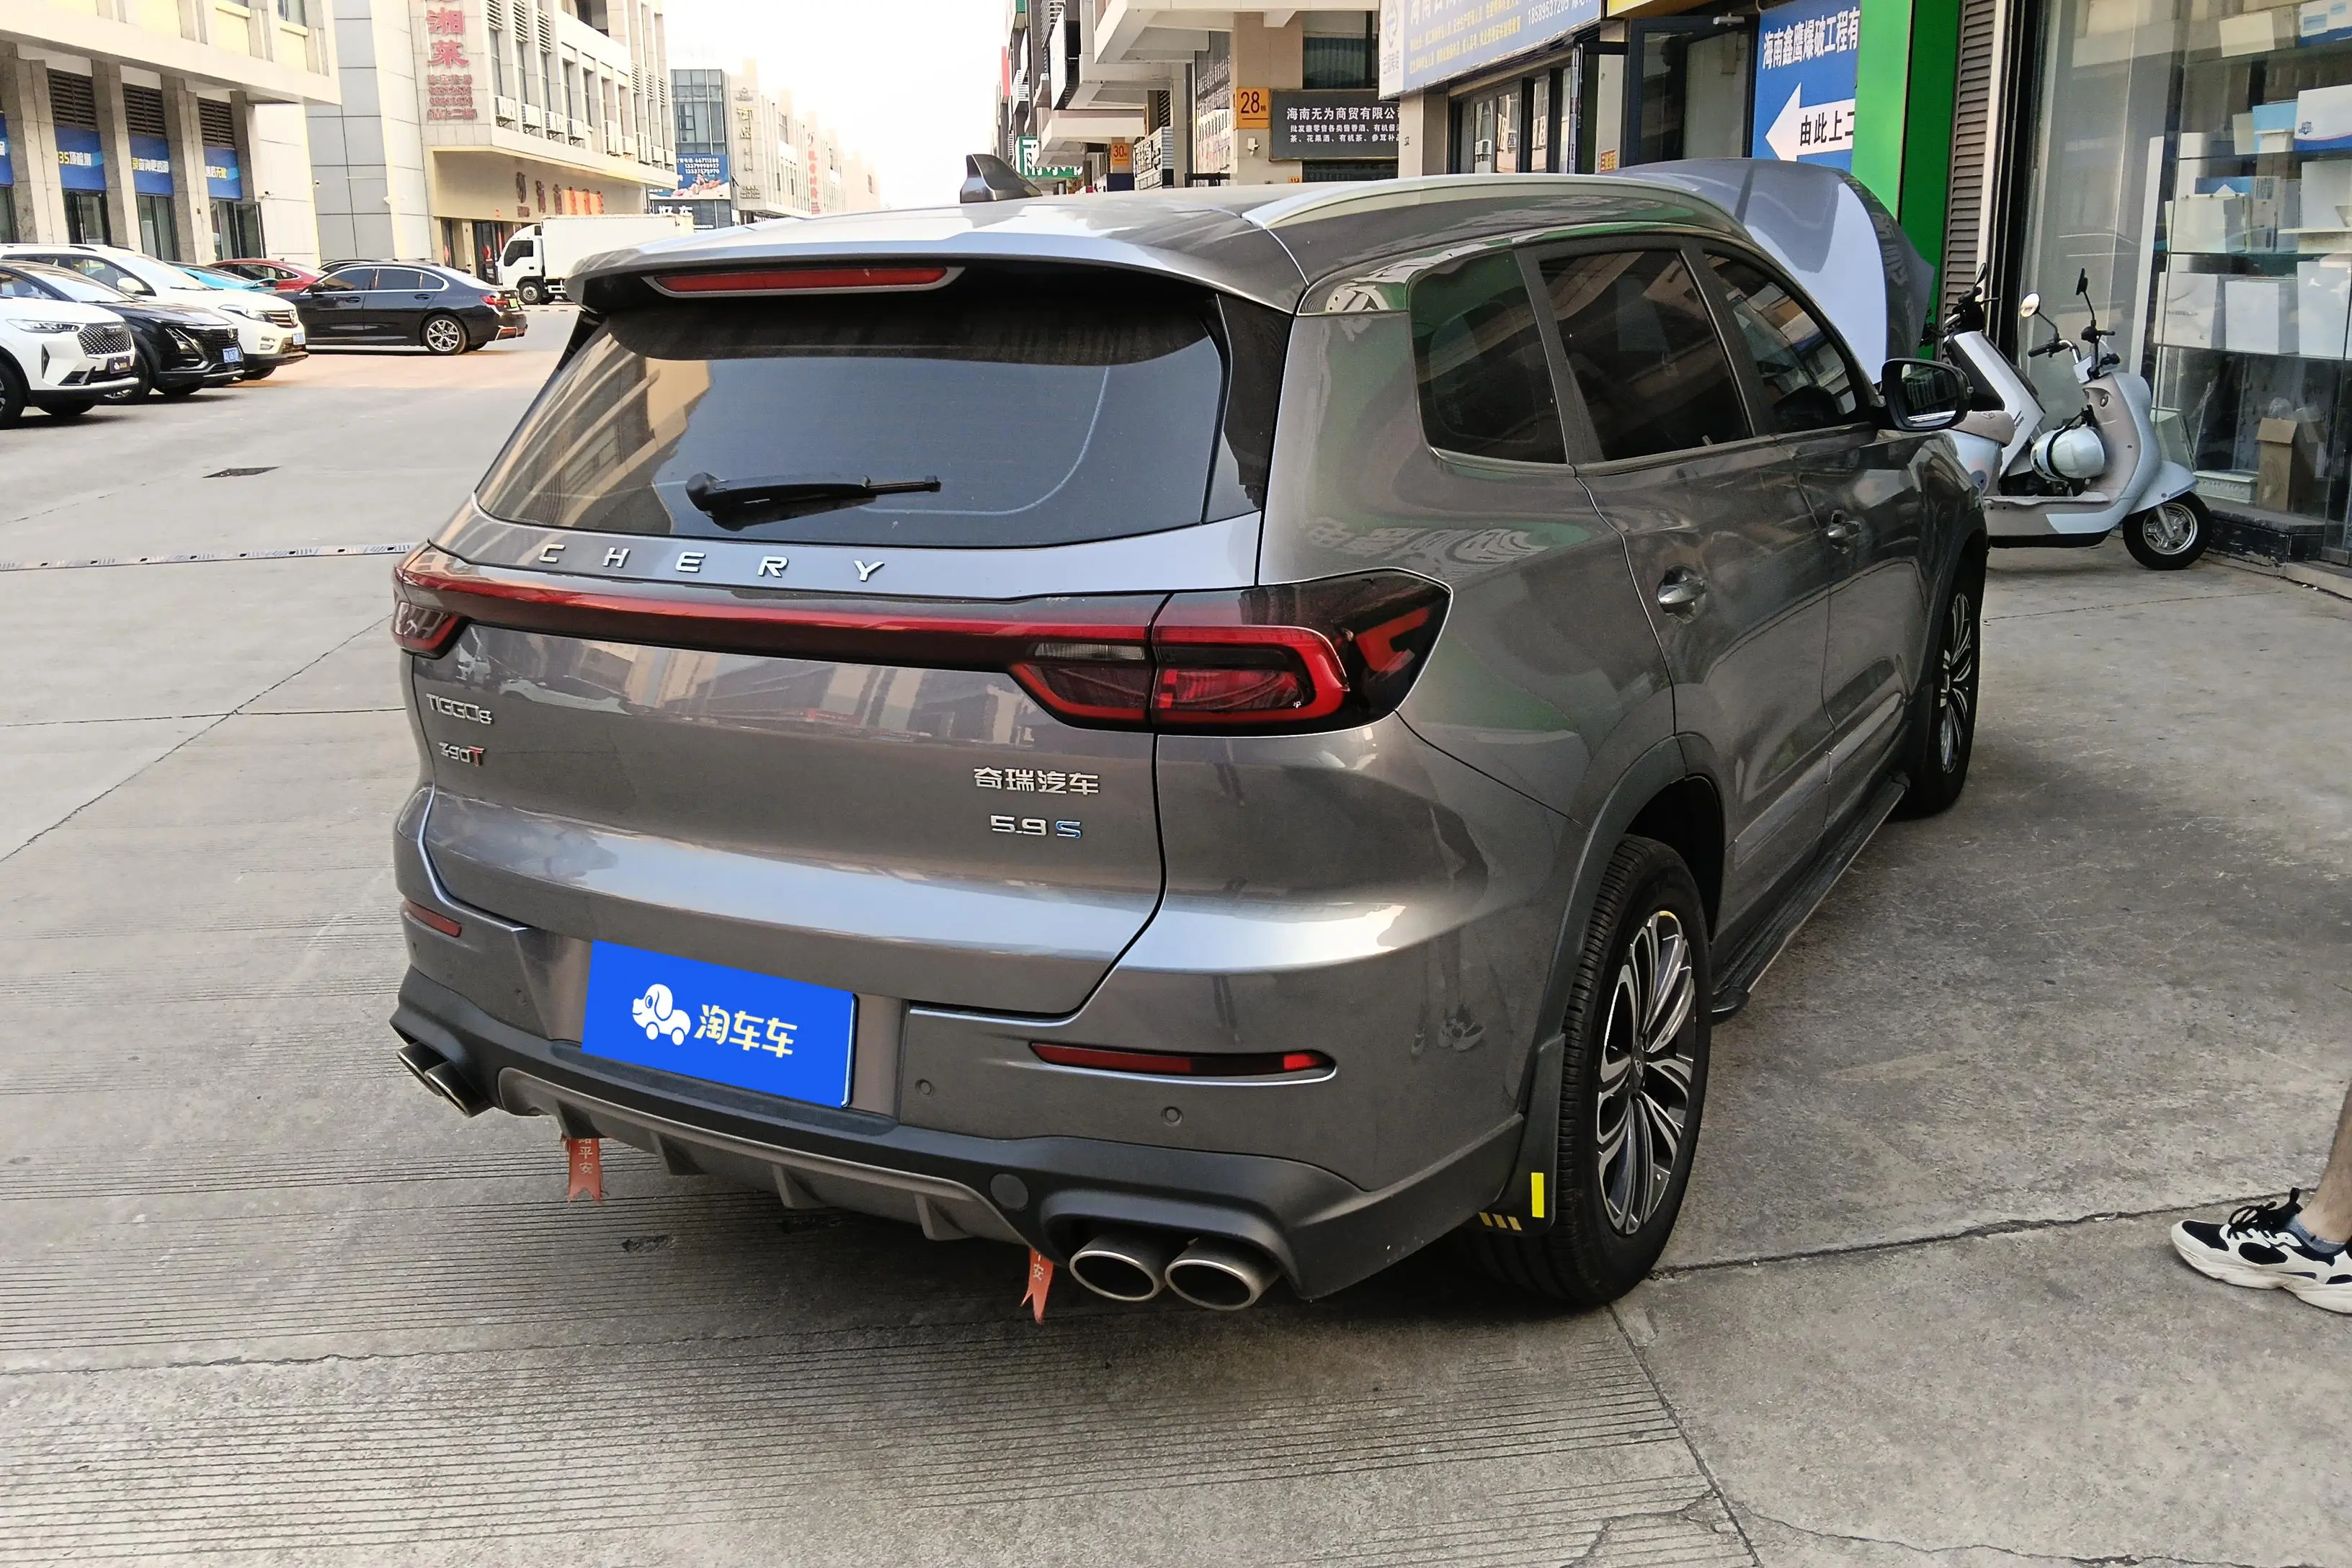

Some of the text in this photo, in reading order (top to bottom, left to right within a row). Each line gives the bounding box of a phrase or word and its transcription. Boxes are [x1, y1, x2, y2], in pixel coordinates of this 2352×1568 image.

[1286, 107, 1399, 120] 海南无为商贸有限公
[539, 543, 885, 582] CHERY
[438, 741, 485, 767] 390T
[974, 766, 1100, 796] 奇瑞汽车
